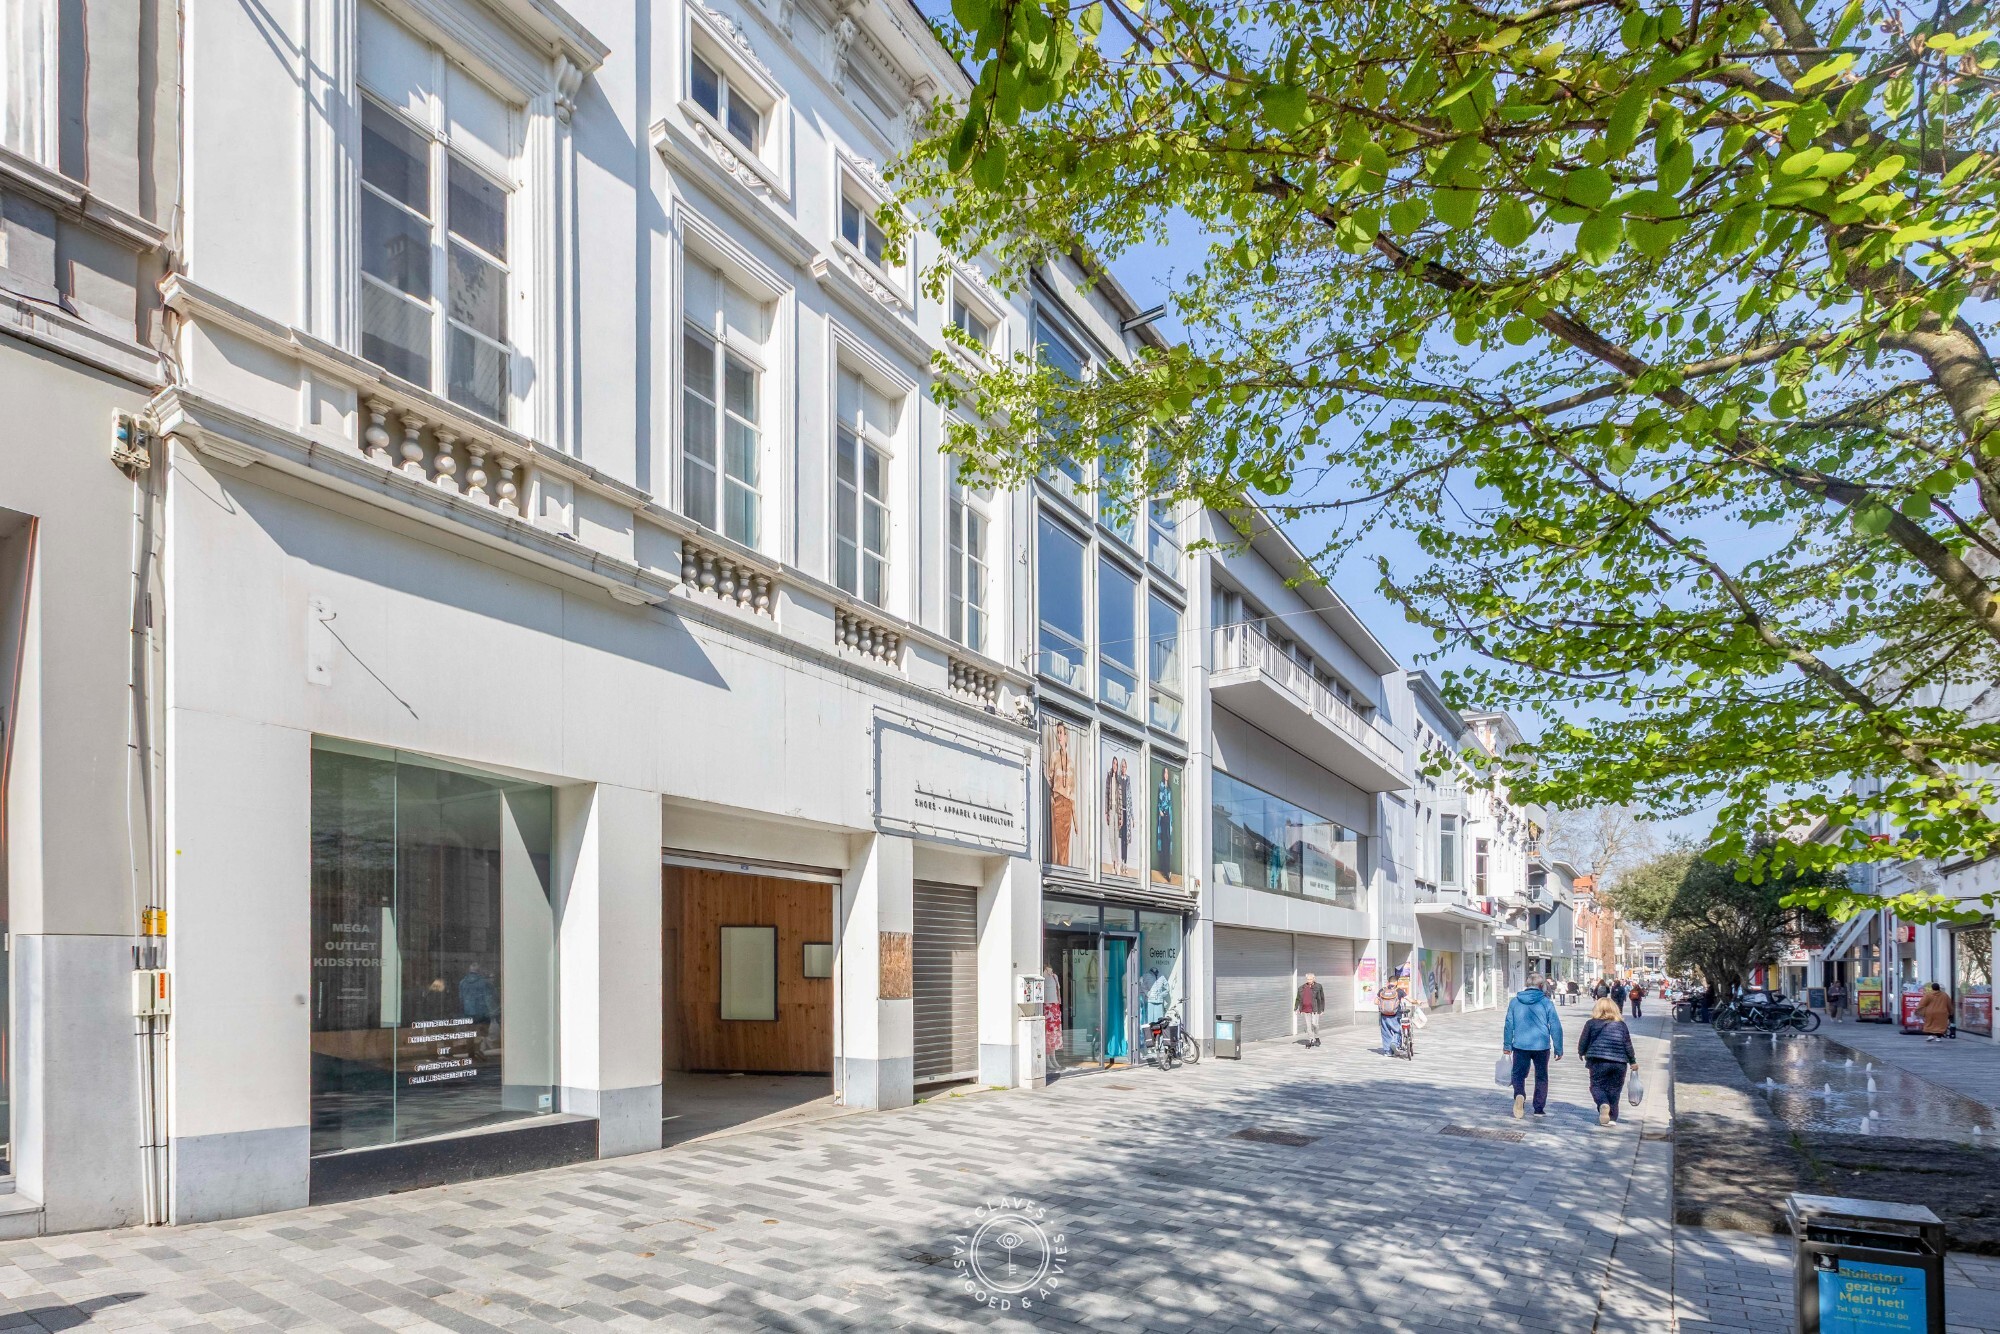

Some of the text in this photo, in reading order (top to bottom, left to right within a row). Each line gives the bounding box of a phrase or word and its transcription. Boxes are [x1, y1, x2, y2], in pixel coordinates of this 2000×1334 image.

[914, 798, 936, 811] SHOES
[944, 805, 971, 819] APPAREL
[972, 812, 977, 820] &
[979, 813, 1014, 828] SUBCULTURE
[332, 923, 370, 933] MEGA
[325, 941, 377, 951] OUTLET
[1149, 947, 1176, 959] Green ICE
[313, 957, 387, 967] KIDSSTORE
[1845, 1282, 1898, 1295] gezien?
[1839, 1292, 1905, 1309] Meld het!
